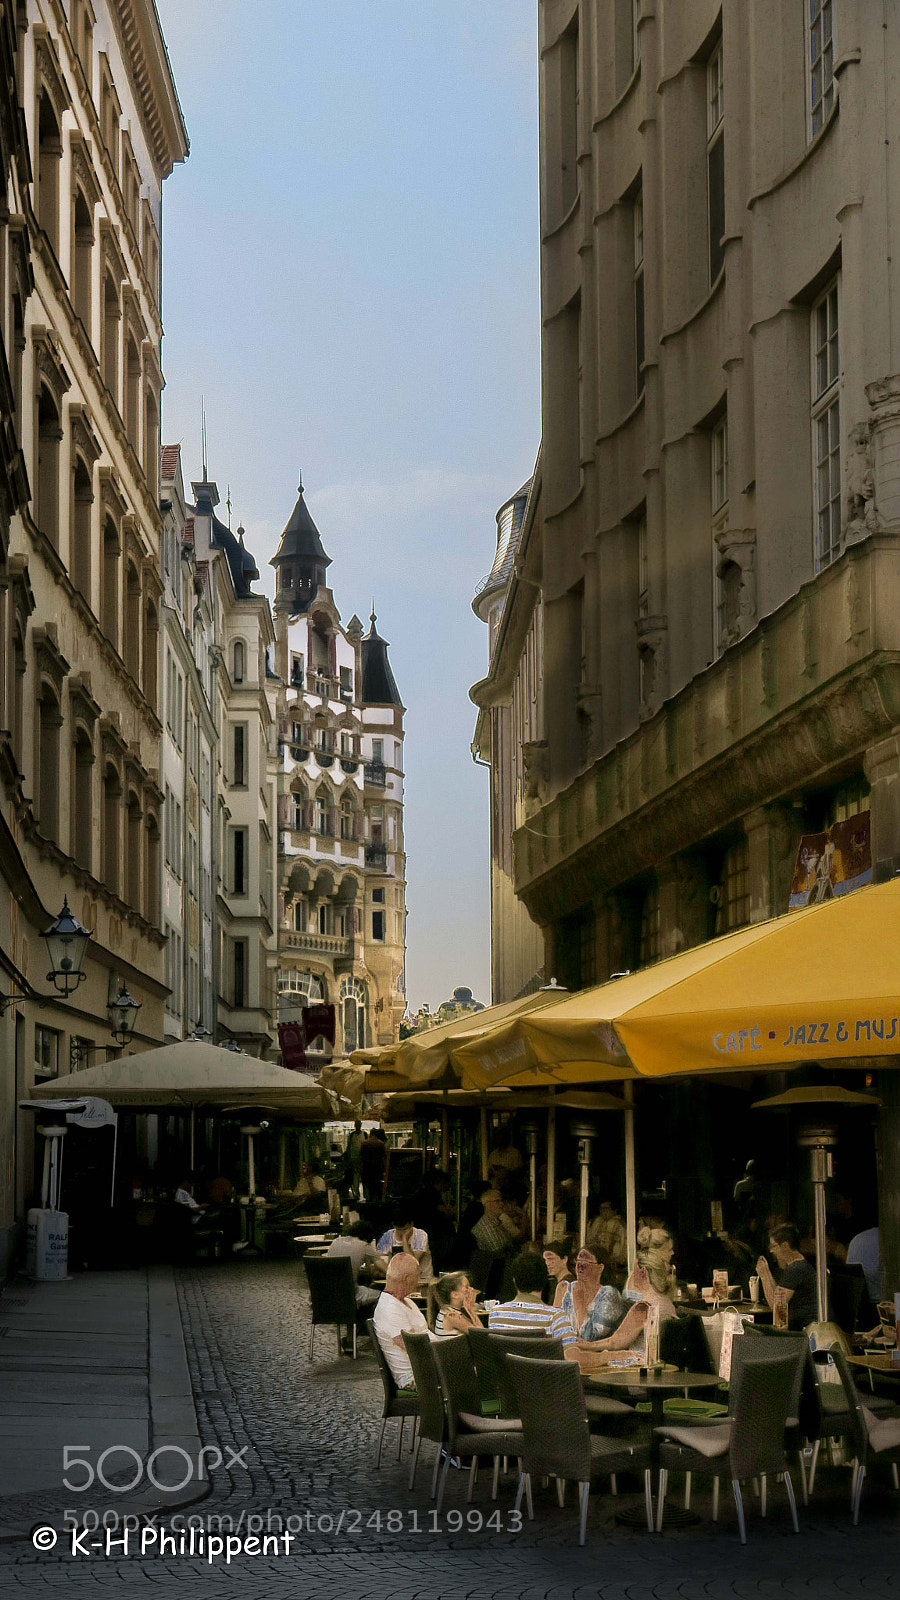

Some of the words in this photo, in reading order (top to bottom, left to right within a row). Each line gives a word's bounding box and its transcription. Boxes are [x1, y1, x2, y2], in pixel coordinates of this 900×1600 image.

[712, 1024, 762, 1053] CAFÉ
[783, 1022, 829, 1046] JAZZ
[836, 1022, 848, 1042] &
[854, 1018, 900, 1041] MUS
